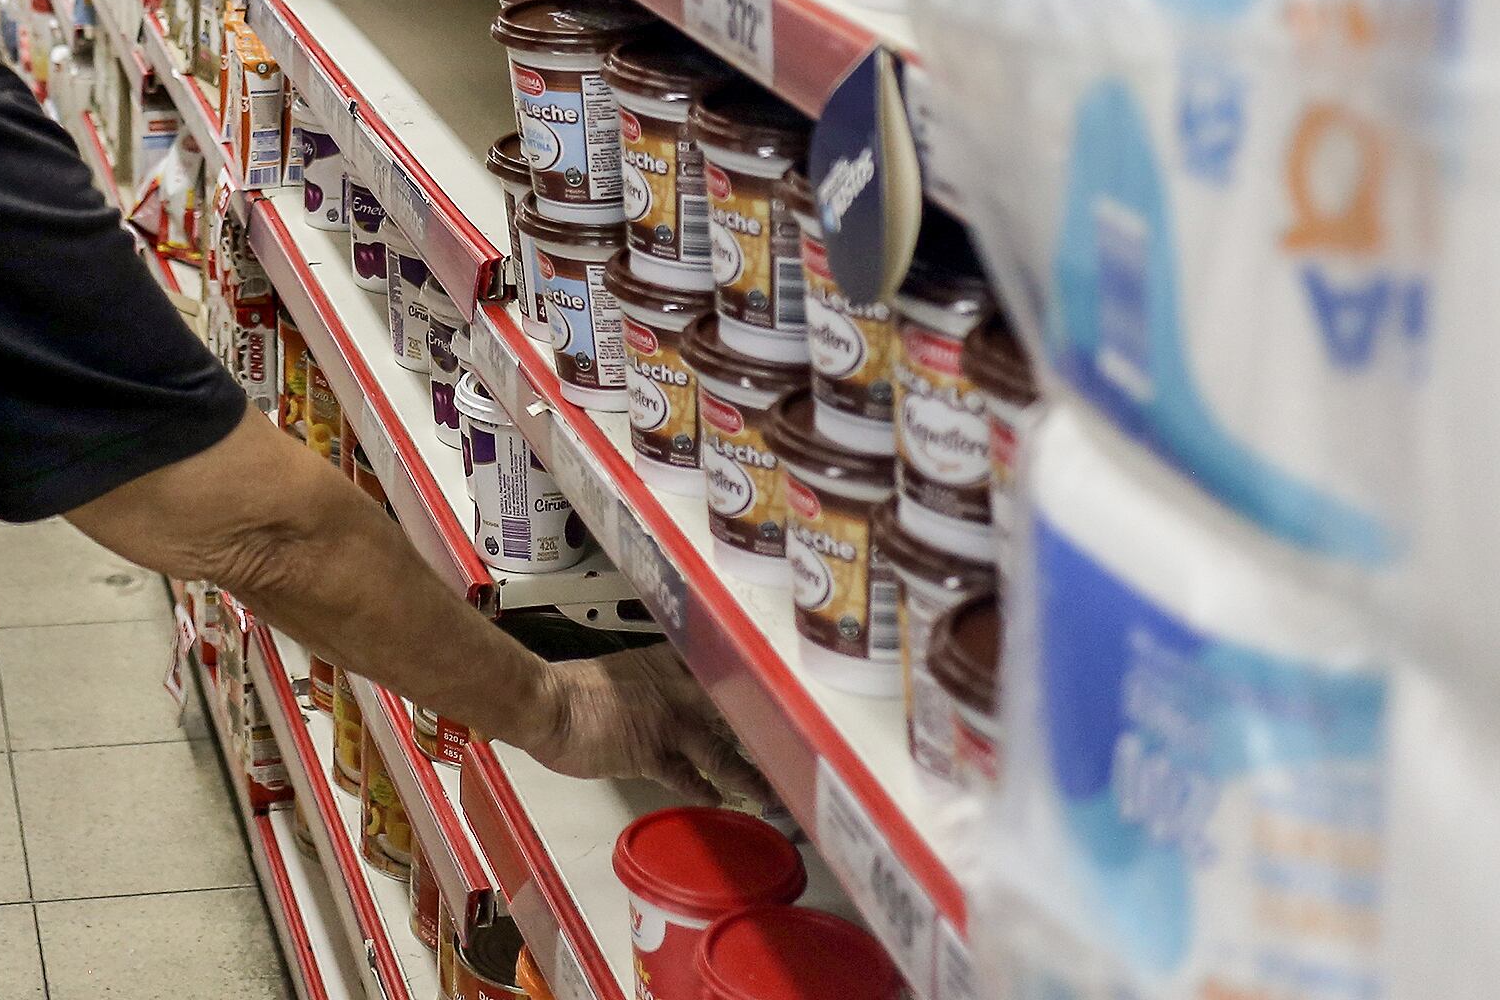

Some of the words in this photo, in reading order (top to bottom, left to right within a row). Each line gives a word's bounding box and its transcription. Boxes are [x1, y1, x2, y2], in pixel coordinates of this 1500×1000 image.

[523, 98, 579, 124] Leche
[633, 356, 689, 386] Leche
[539, 542, 555, 551] 420
[443, 731, 459, 743] 820
[443, 747, 458, 760] 485
